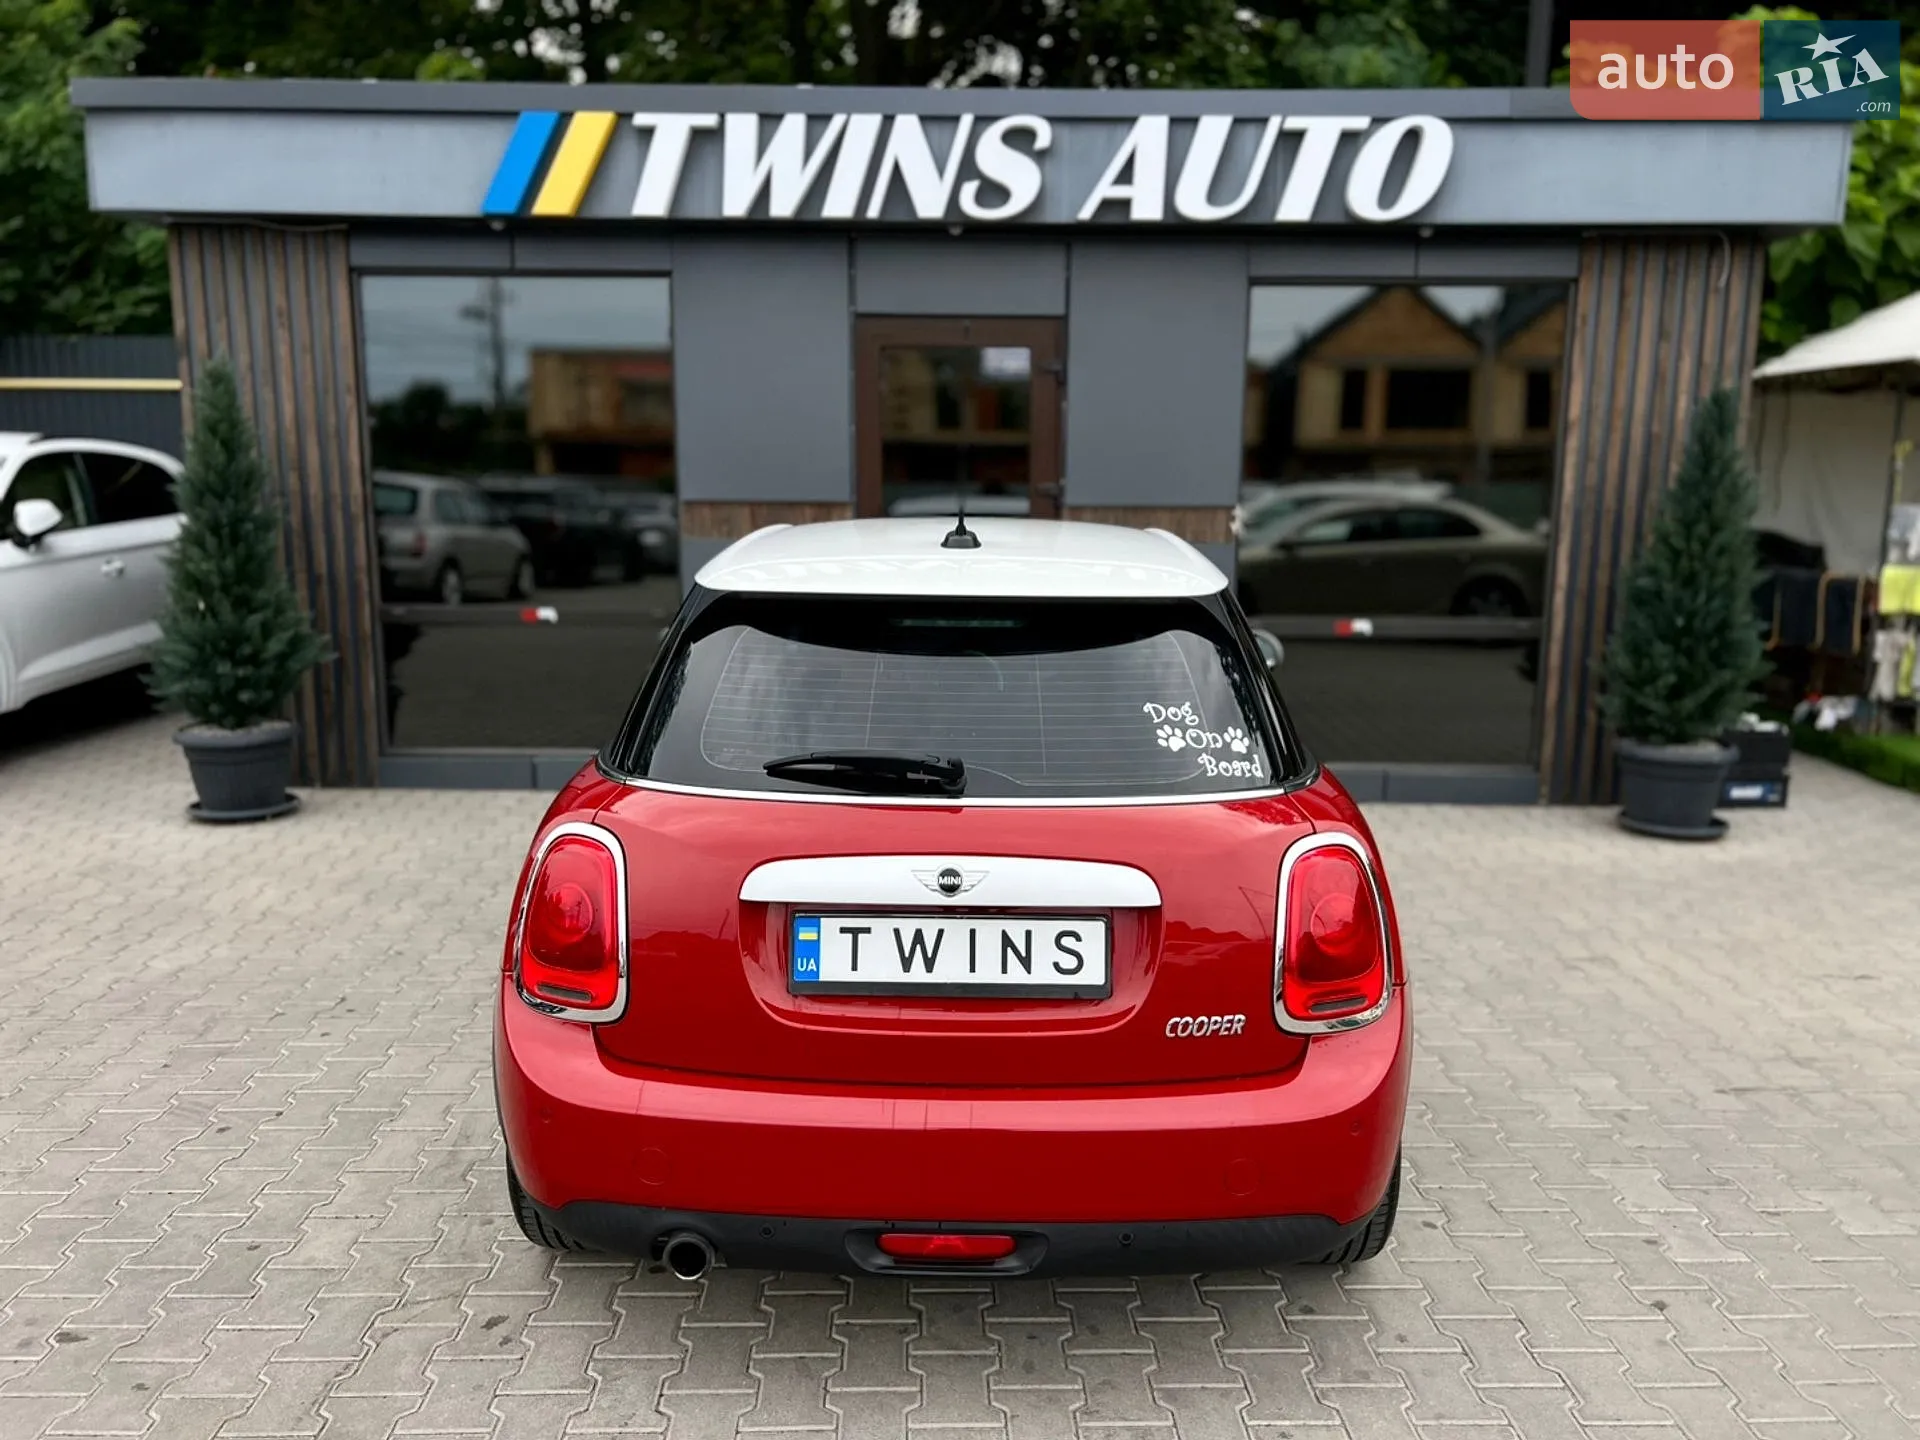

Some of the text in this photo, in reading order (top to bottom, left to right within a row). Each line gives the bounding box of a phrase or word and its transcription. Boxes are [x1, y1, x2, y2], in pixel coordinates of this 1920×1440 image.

[631, 112, 1454, 222] TWINS AUTO
[1142, 701, 1199, 726] Dog
[1185, 728, 1223, 748] On
[1197, 752, 1264, 778] Board
[938, 875, 962, 885] MINI
[839, 926, 1085, 976] TWINS
[797, 957, 818, 972] UA
[1165, 1013, 1246, 1037] COOPER
